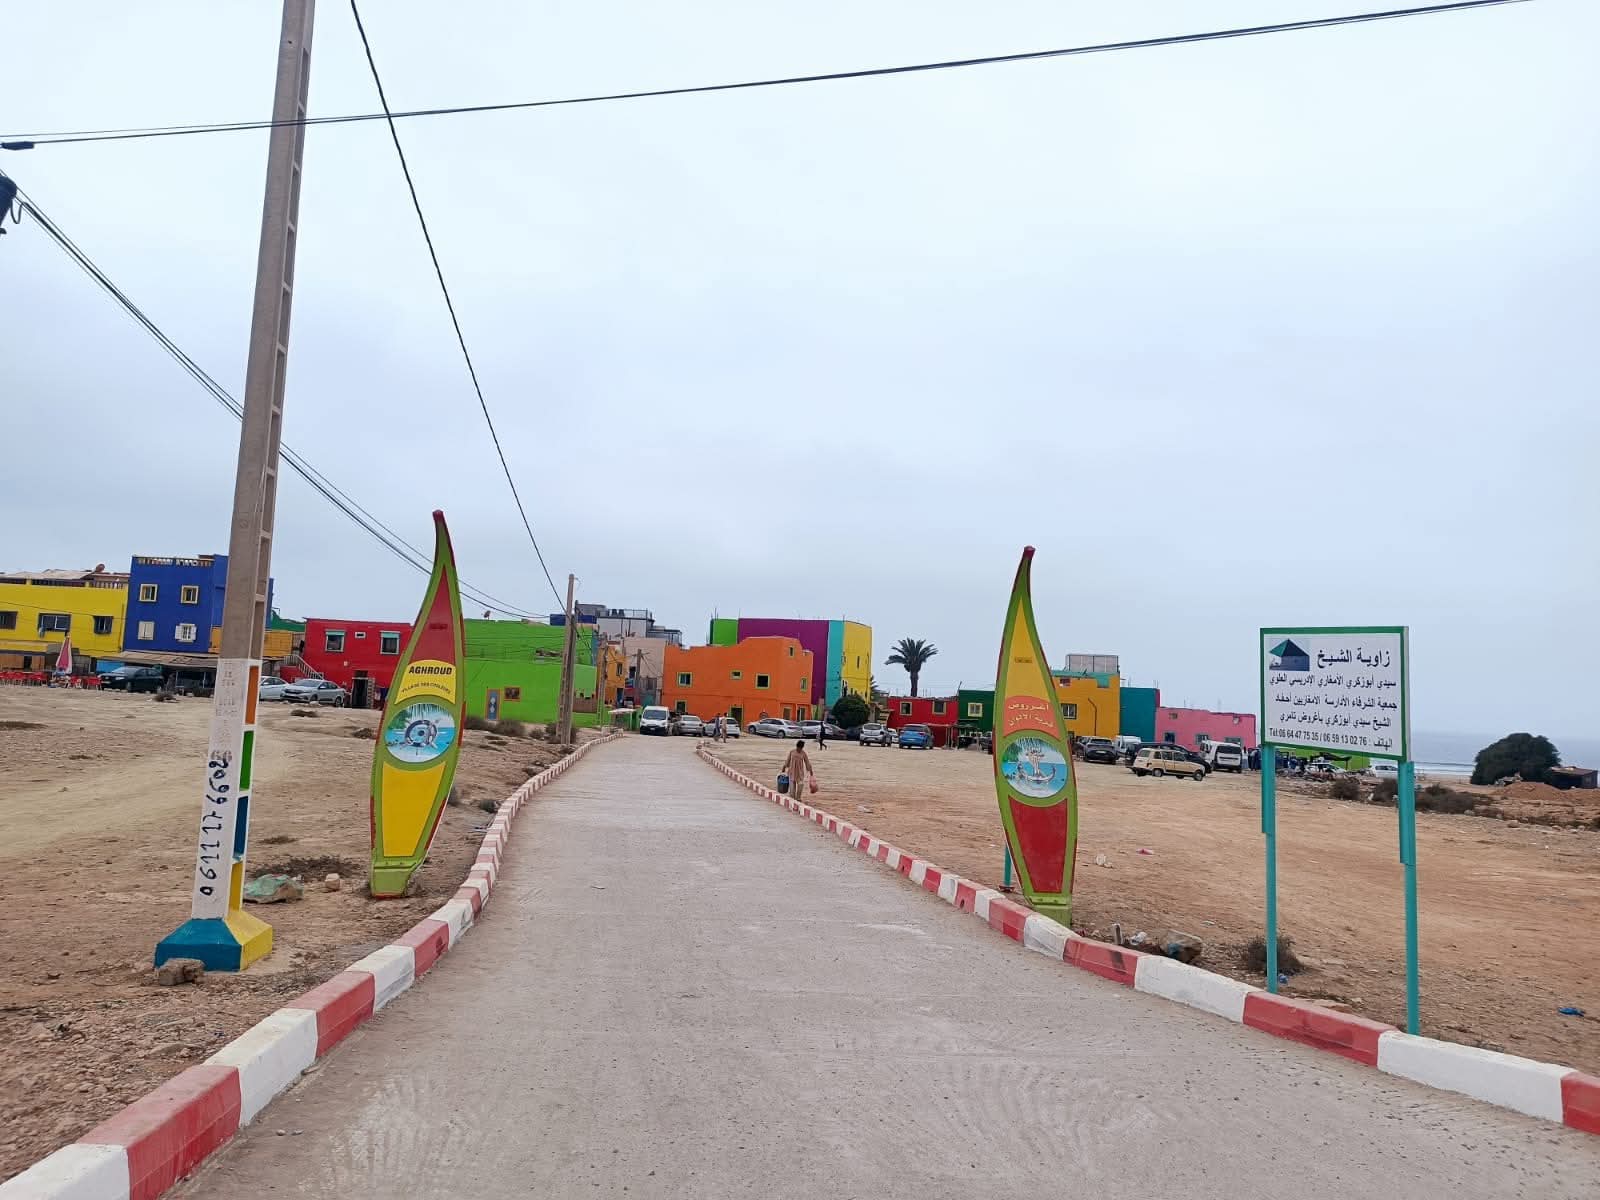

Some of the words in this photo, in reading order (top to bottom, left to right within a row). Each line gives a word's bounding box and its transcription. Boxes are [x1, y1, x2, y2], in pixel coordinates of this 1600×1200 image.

[1317, 649, 1352, 669] الشيخ
[1356, 647, 1391, 668] زاوية
[408, 666, 452, 675] AGHROUD
[1372, 716, 1392, 731] الشيخ
[1287, 729, 1294, 739] 64
[1295, 730, 1302, 739] 47
[1303, 730, 1311, 740] 75
